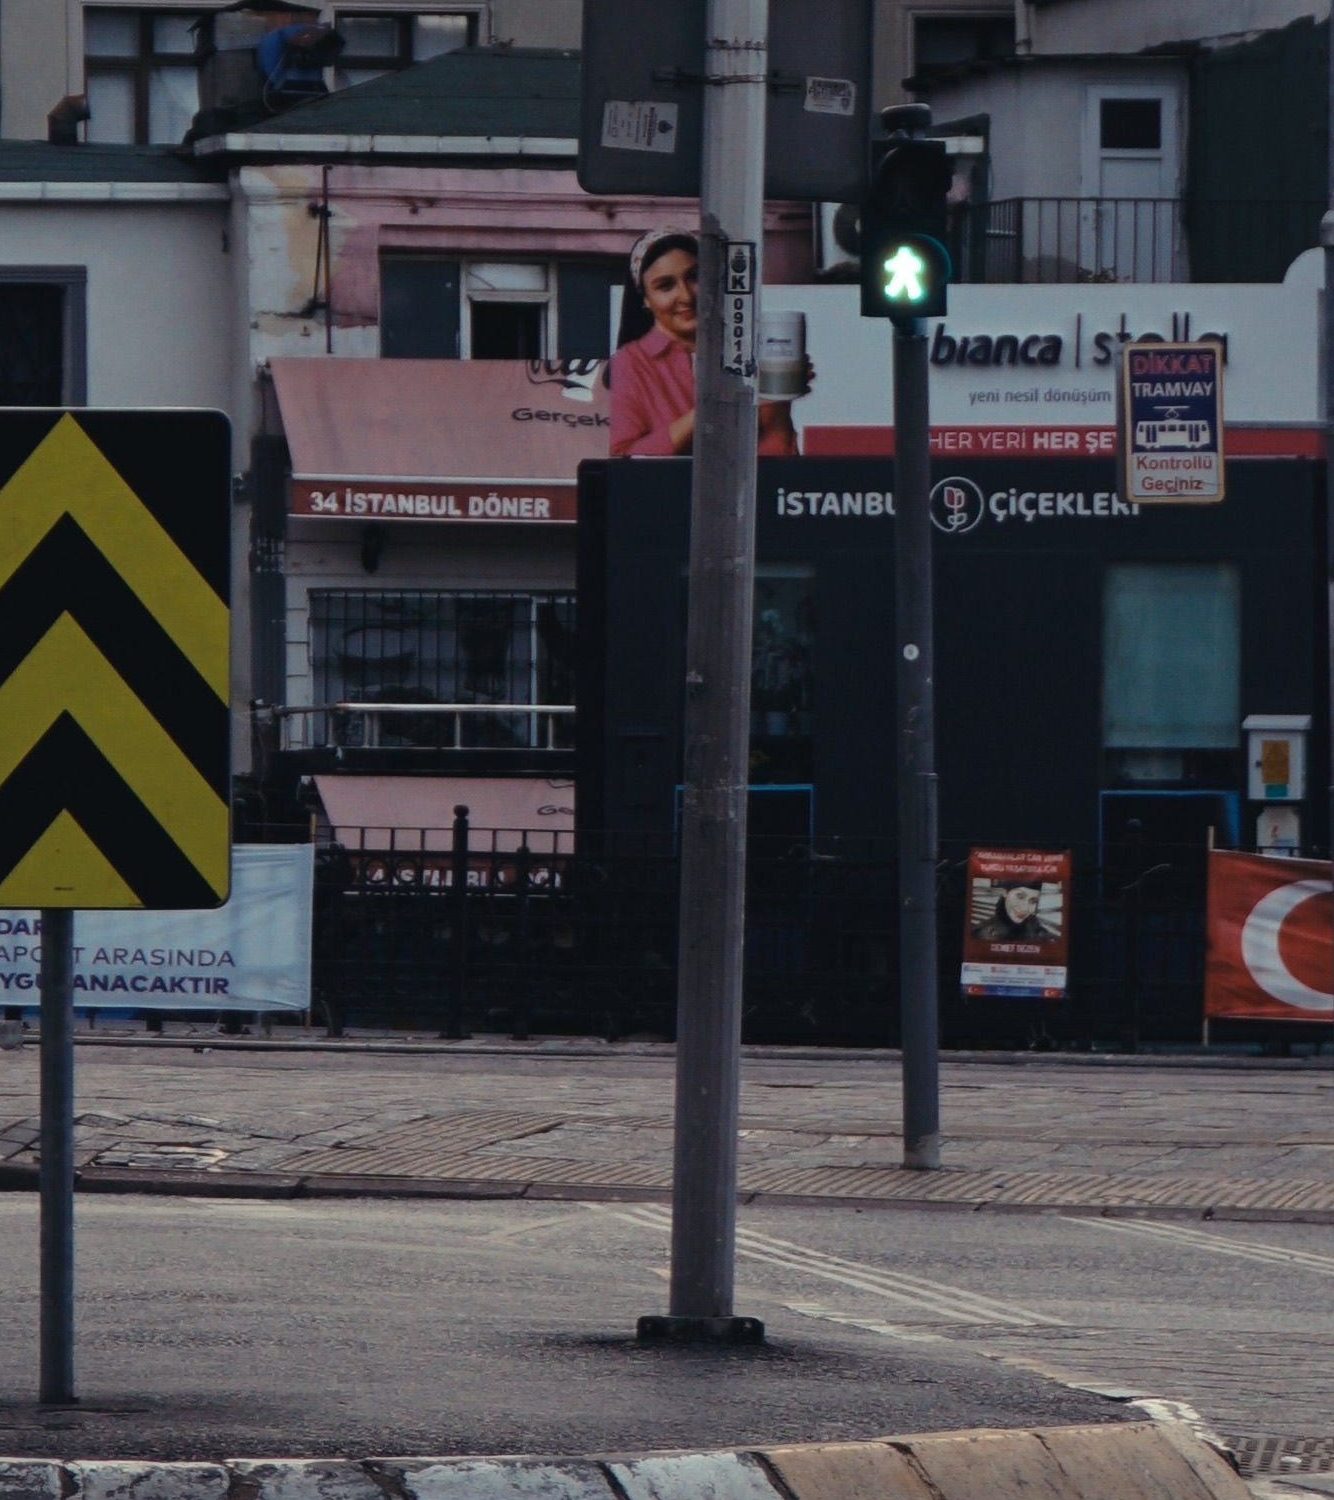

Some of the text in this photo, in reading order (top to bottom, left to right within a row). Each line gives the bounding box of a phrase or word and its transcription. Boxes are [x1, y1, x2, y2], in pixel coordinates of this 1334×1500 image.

[731, 275, 745, 290] K
[1133, 351, 1213, 374] DİKKAT
[969, 386, 1111, 405] yeni nesil dönüşüm
[1133, 382, 1213, 398] TRAMVAY
[512, 407, 610, 427] Gerçek
[929, 432, 972, 449] HER
[979, 428, 1026, 449] YERİ
[1034, 433, 1079, 449] HER
[1136, 456, 1213, 470] Kontrollü
[1141, 476, 1204, 493] Geçiniz
[310, 488, 551, 519] 34 İSTANBUL DÖNER
[777, 488, 895, 516] İSTANBU
[92, 948, 236, 968] ARASINDA
